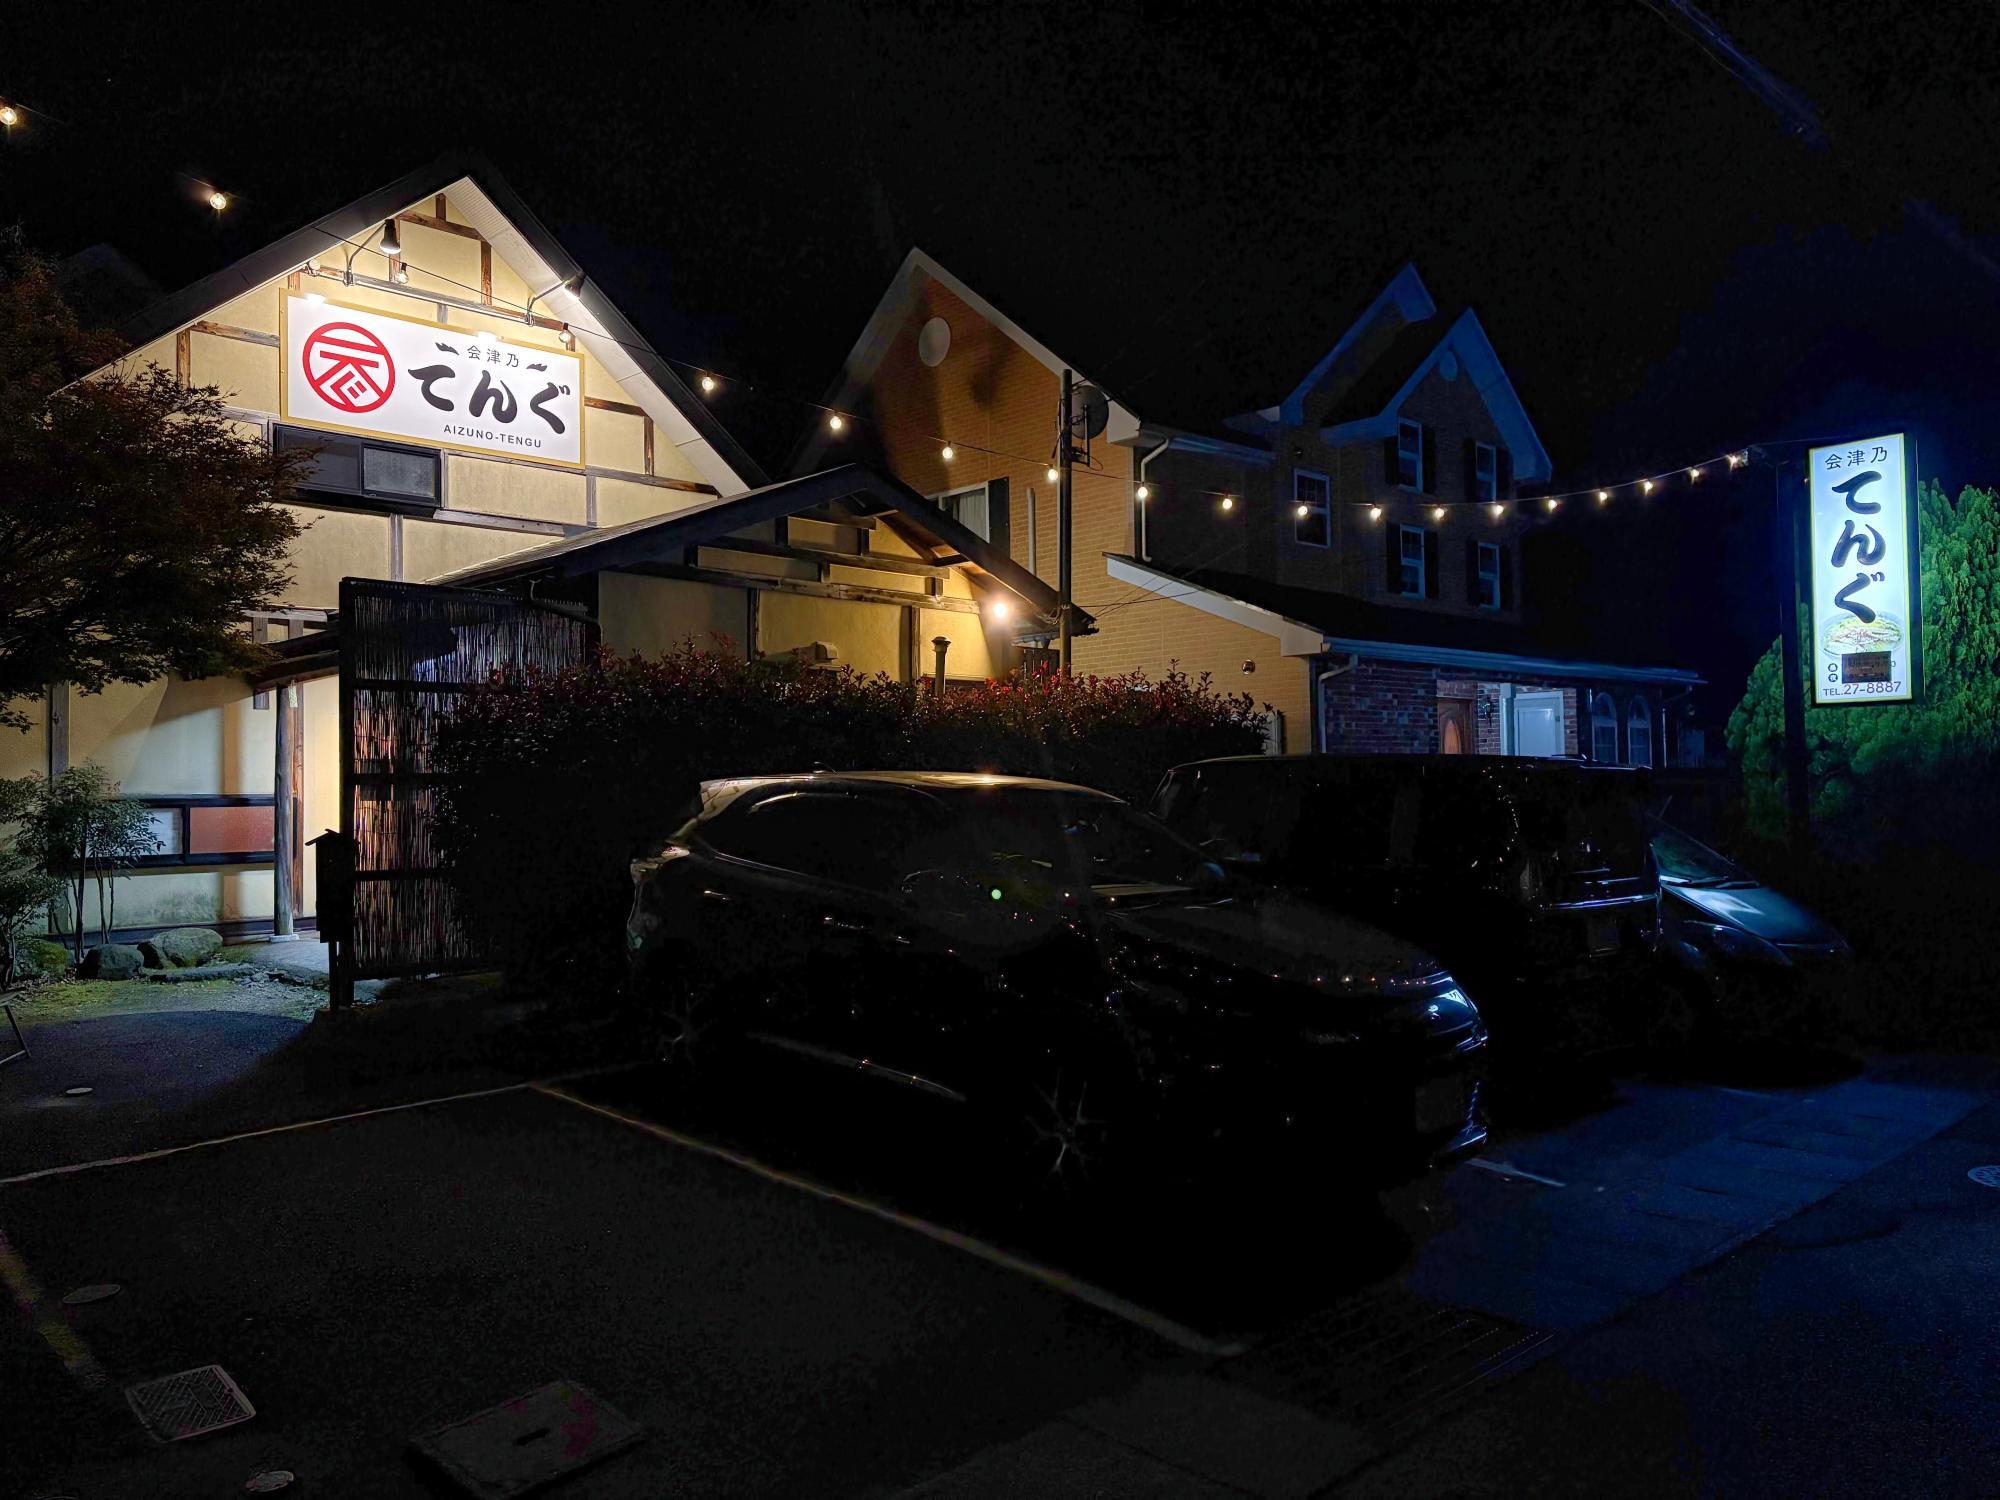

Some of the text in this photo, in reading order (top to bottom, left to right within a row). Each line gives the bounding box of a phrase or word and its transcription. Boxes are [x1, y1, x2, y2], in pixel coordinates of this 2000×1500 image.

[467, 346, 519, 367] 会津乃
[407, 364, 571, 435] てんぐ
[444, 424, 542, 447] AIZUNO-TENGU
[1825, 446, 1888, 469] 会津乃
[1831, 470, 1886, 624] てんぐ
